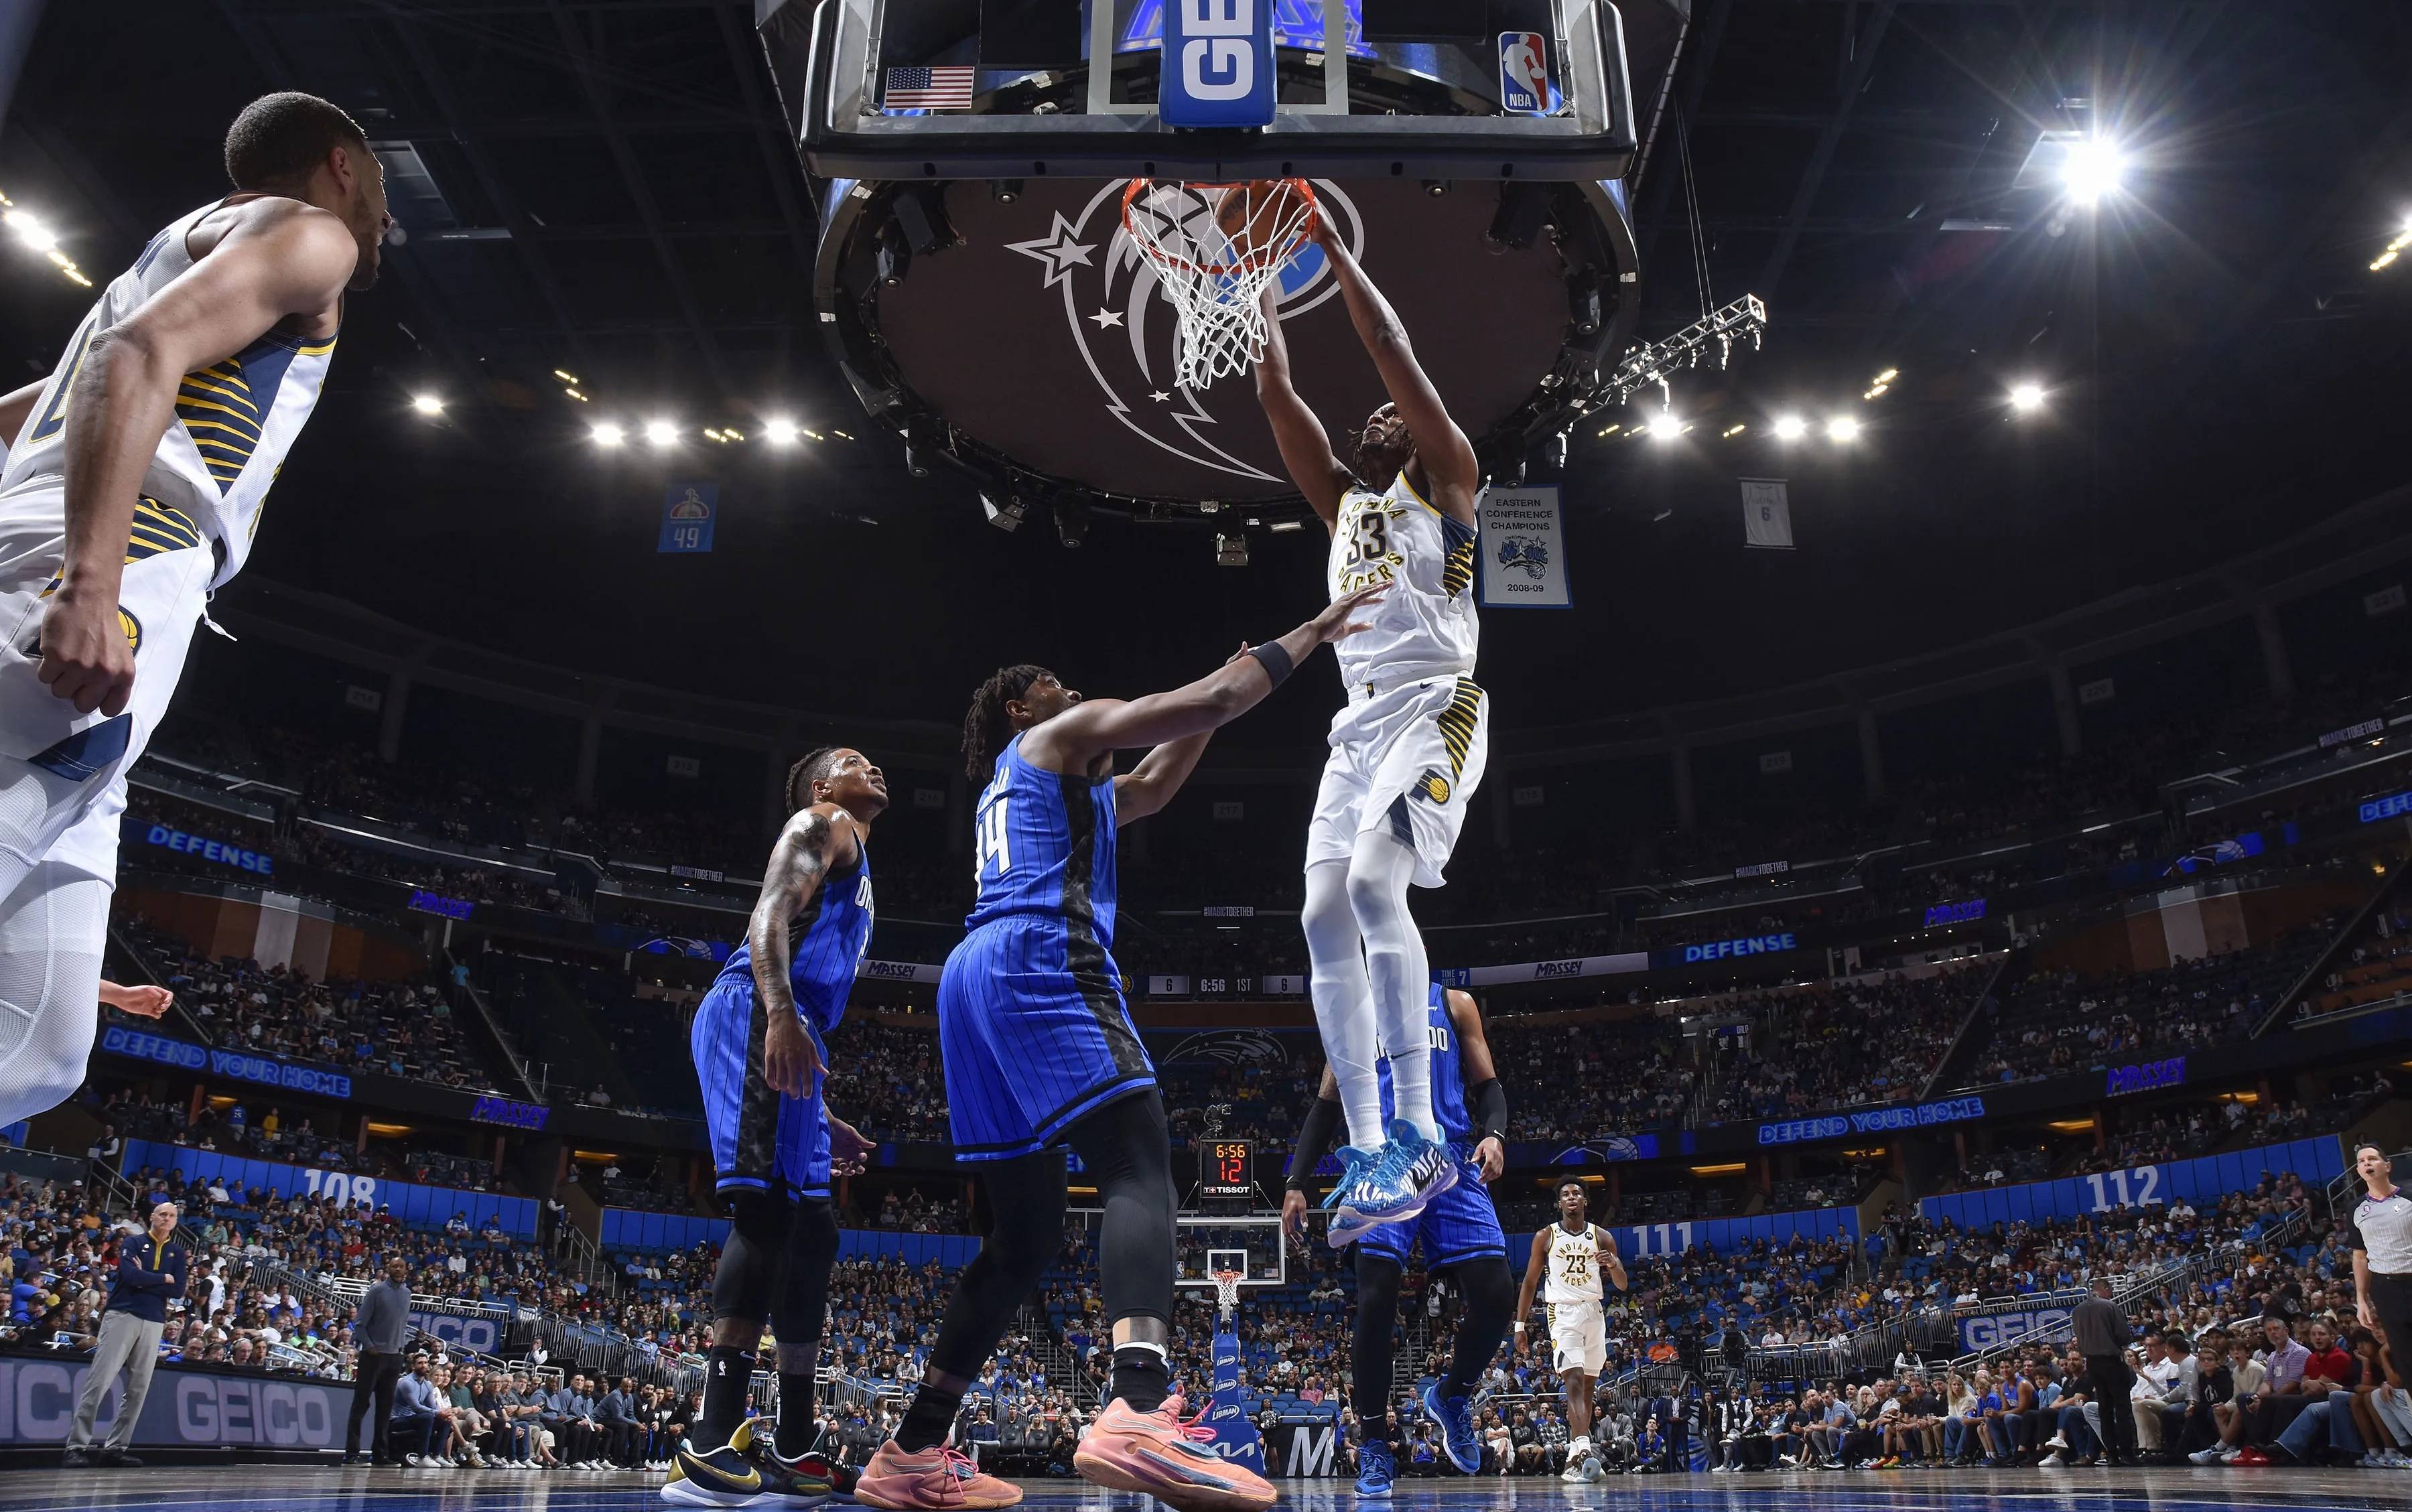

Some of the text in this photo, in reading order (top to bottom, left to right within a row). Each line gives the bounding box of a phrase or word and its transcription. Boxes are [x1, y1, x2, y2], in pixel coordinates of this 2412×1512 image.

[1509, 93, 1532, 107] NBA
[1496, 498, 1541, 507] EASTERN
[1486, 510, 1554, 519] CONFERENCE
[1761, 506, 1771, 521] 6
[1491, 522, 1550, 531] CHAMPIONS
[674, 527, 699, 548] 49
[1346, 511, 1387, 566] 33
[1508, 583, 1544, 592] 2008-09
[147, 825, 273, 874] DEFENSE
[671, 864, 723, 882] #MAGICTOGETHER
[1735, 861, 1788, 879] #MAGICTOGETHER
[1203, 906, 1254, 917] #MAGICTOGETHER
[1685, 933, 1797, 962] DEFENSE
[868, 961, 917, 977] MASSEY
[1441, 969, 1455, 978] TIME
[1535, 961, 1583, 977] MASSEY
[1166, 978, 1172, 991] 6
[1201, 978, 1252, 992] 6:56 1ST
[1281, 978, 1288, 991] 6
[1459, 970, 1467, 985] 7
[103, 1027, 351, 1097] DEFEND YOUR HOME
[2106, 1056, 2186, 1095] MASSEY
[472, 1095, 550, 1130] MASSEY
[1759, 1097, 1985, 1144] DEFEND YOUR HOME
[1216, 1145, 1246, 1158] 6:56
[1221, 1160, 1242, 1182] 12
[306, 1169, 375, 1211] 108
[2086, 1165, 2162, 1213] 112
[1633, 1221, 1691, 1260] 111
[1556, 1242, 1594, 1259] INDIANA
[1566, 1255, 1586, 1274] 23
[1559, 1272, 1593, 1286] PACERS
[1217, 1357, 1234, 1367] LIBMAN
[1215, 1380, 1235, 1391] LIBMAN
[176, 1375, 332, 1445] GEICO
[1211, 1406, 1238, 1421] LIBMAN
[1286, 1427, 1337, 1476] M
